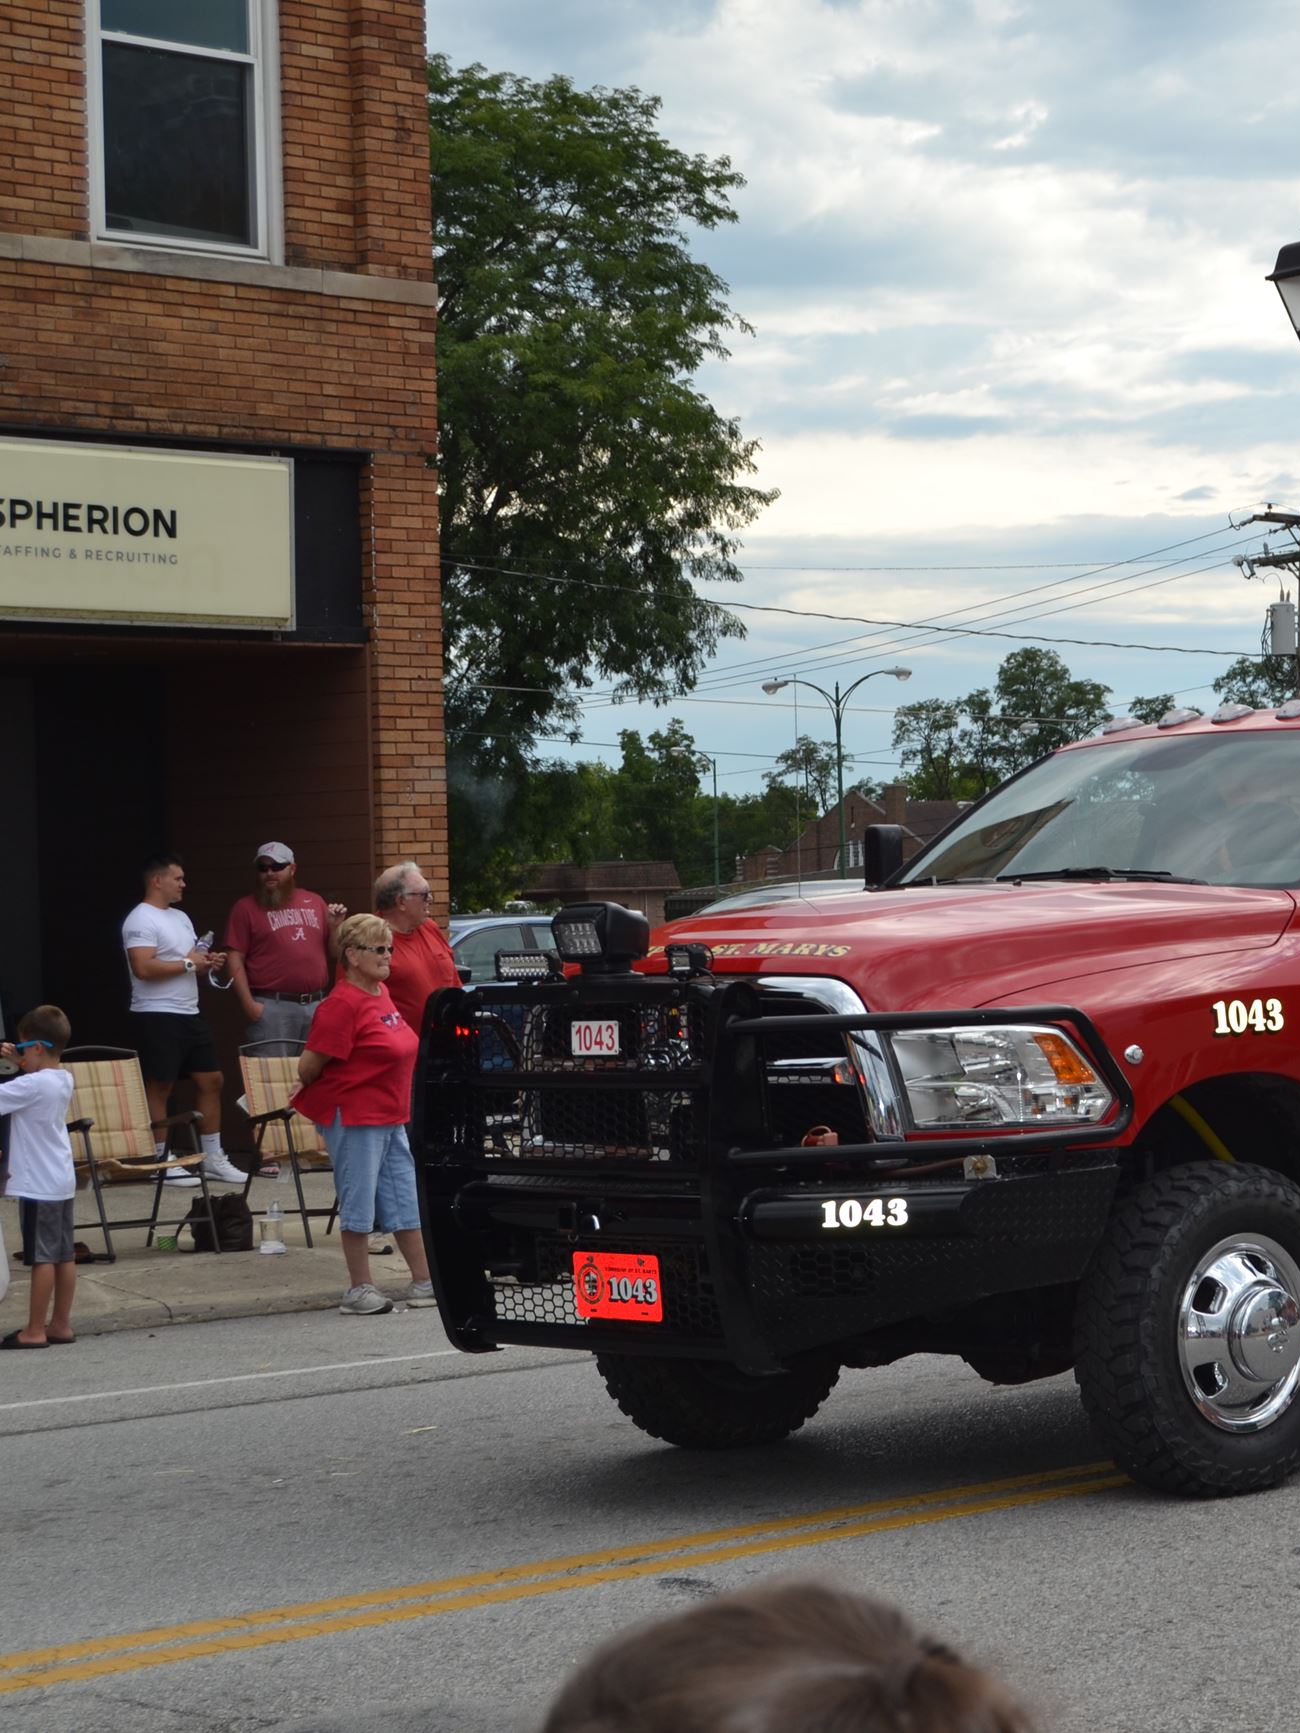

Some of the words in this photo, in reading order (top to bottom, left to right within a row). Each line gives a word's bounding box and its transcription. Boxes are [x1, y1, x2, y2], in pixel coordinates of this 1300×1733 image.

[0, 498, 177, 538] PHERION
[0, 545, 62, 559] AFFING
[69, 549, 77, 560] &
[85, 549, 178, 566] RECRUITING
[267, 908, 304, 932] CRIMSON
[291, 927, 307, 941] A
[748, 942, 852, 958] MARYS
[1212, 998, 1285, 1034] 1043
[575, 1024, 616, 1051] 1043
[821, 1198, 909, 1228] 1043
[608, 1277, 659, 1304] 1043
